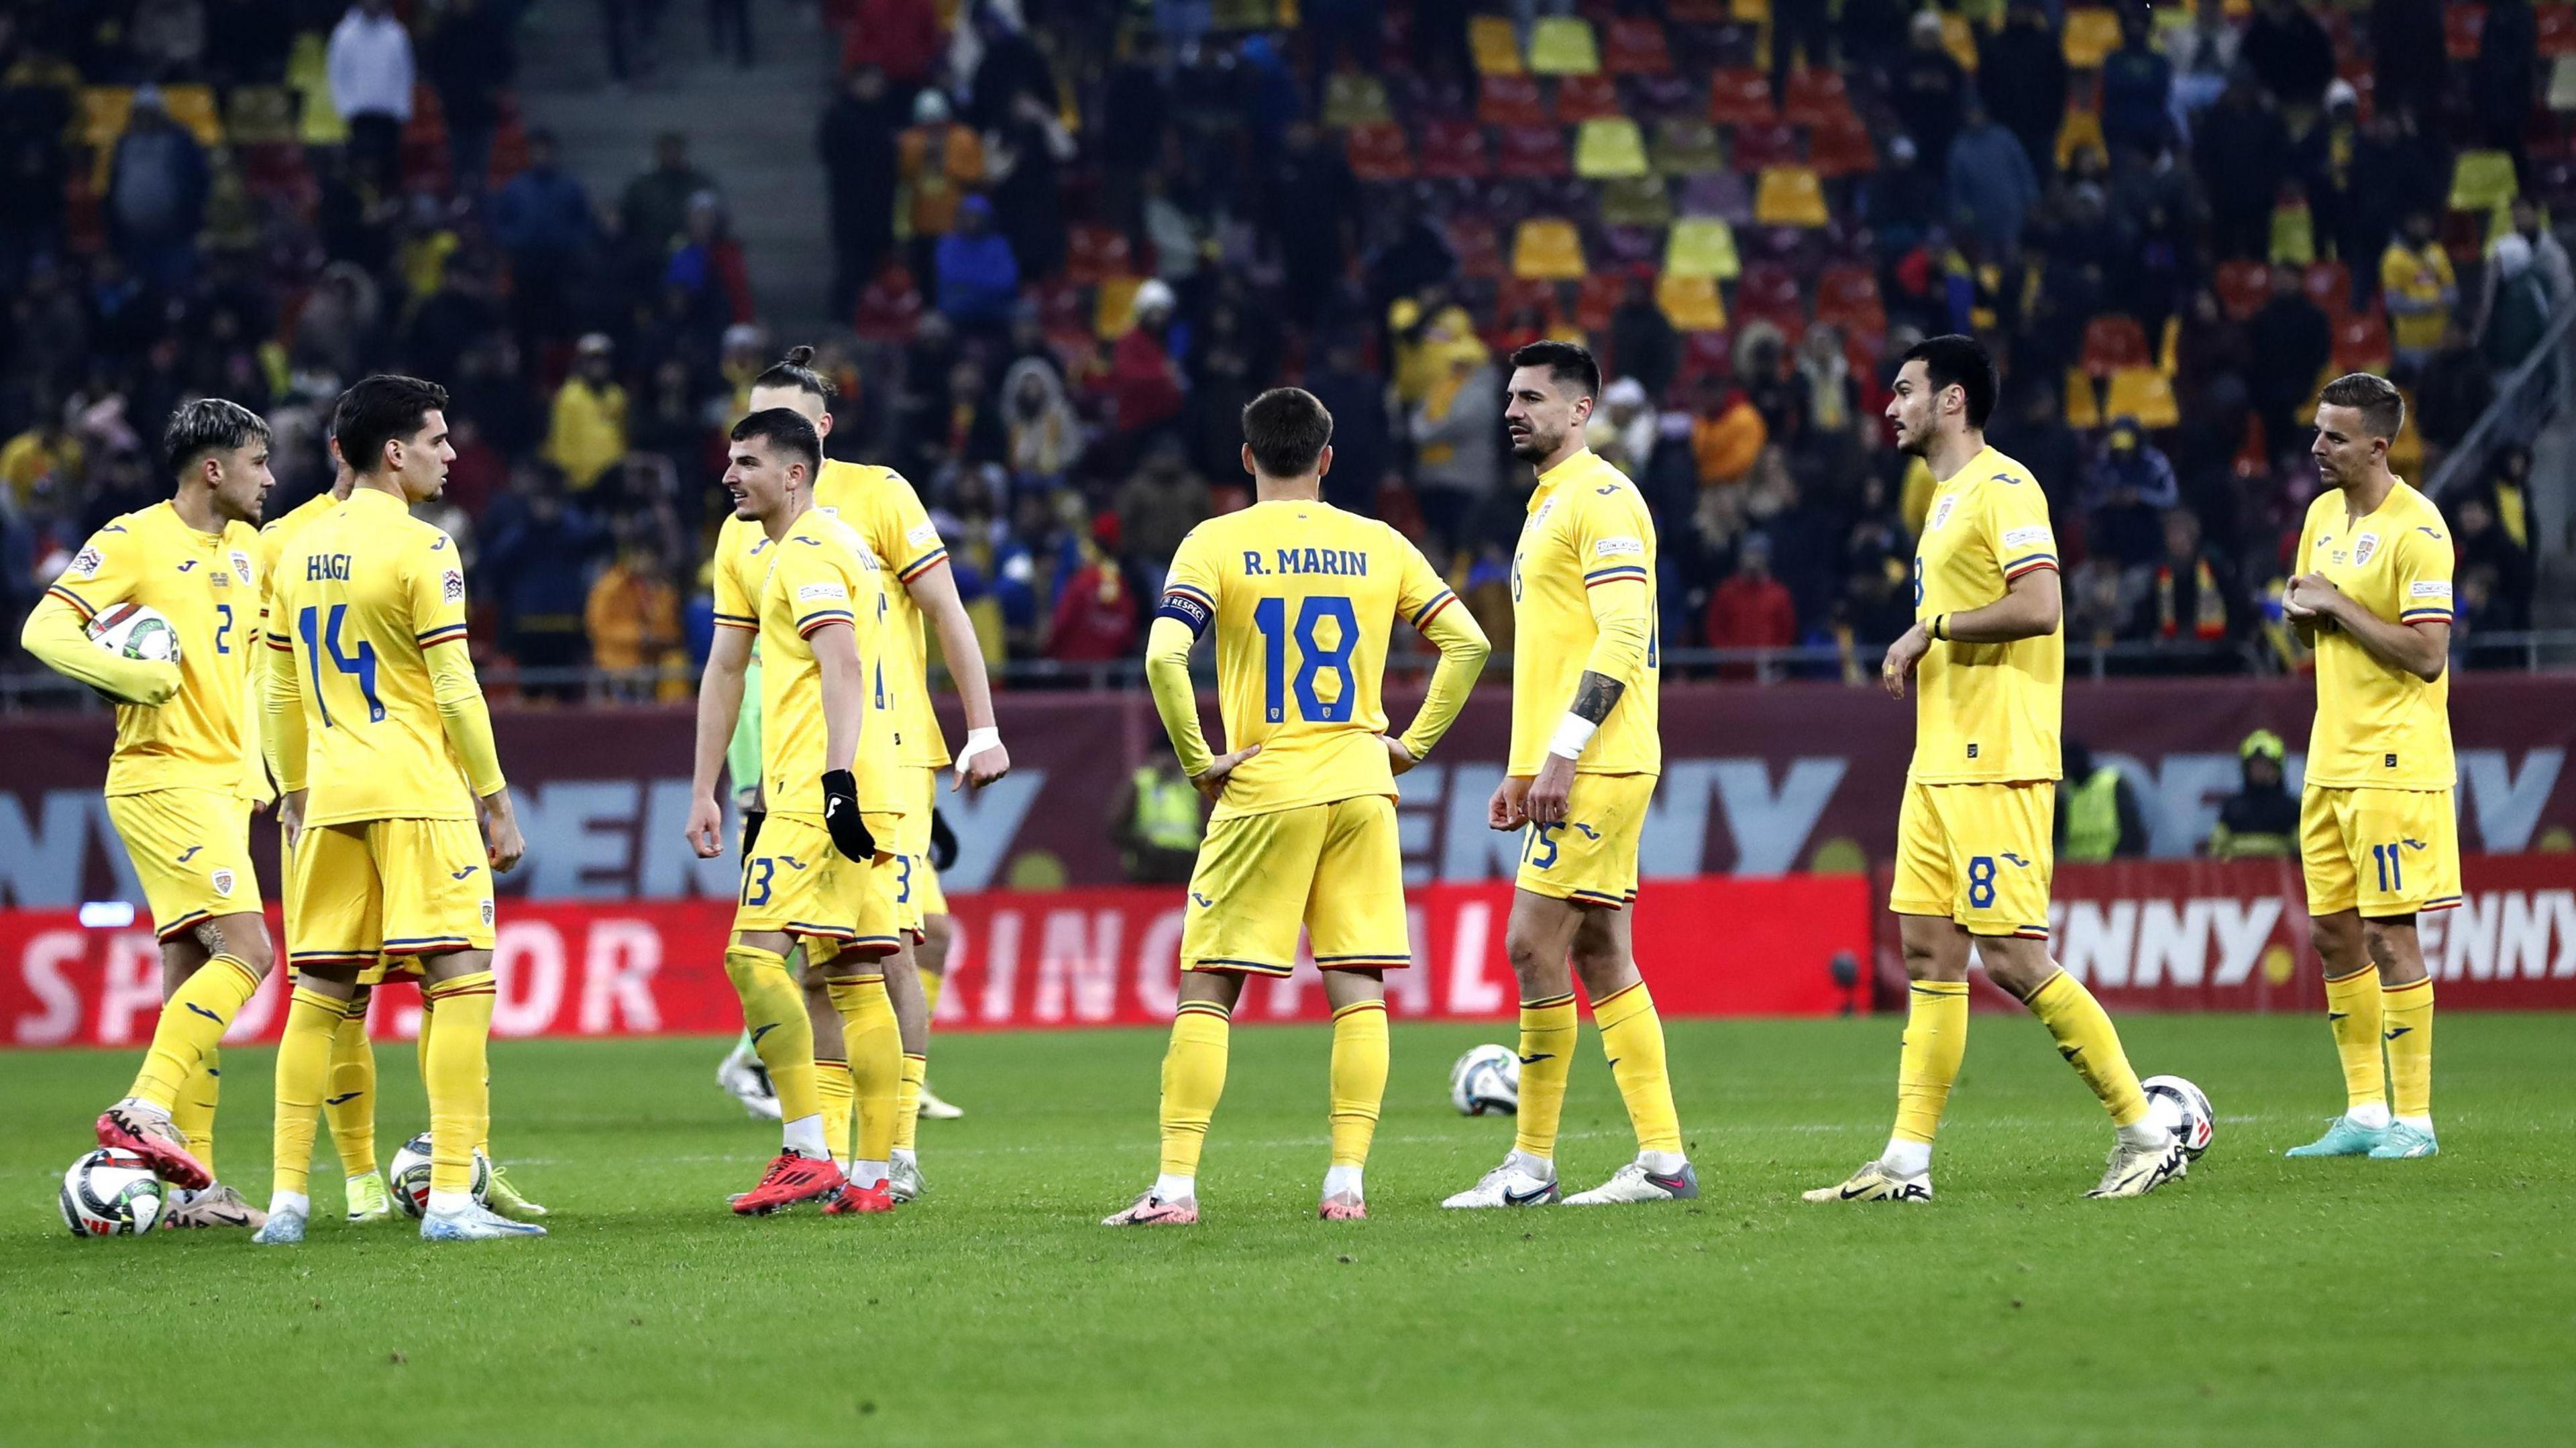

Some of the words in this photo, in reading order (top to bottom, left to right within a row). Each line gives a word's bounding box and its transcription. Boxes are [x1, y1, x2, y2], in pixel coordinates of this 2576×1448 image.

[307, 554, 352, 581] HAGI
[1244, 551, 1271, 575] R.
[1277, 548, 1366, 576] MARIN
[215, 604, 233, 654] 2
[1171, 598, 1205, 621] RESPECT
[299, 604, 386, 728] 14
[1254, 596, 1360, 722] 18
[1523, 820, 1566, 869] 15
[2373, 843, 2402, 892] 11
[742, 857, 775, 906] 13
[896, 854, 910, 903] 3
[1968, 856, 1996, 908] 8
